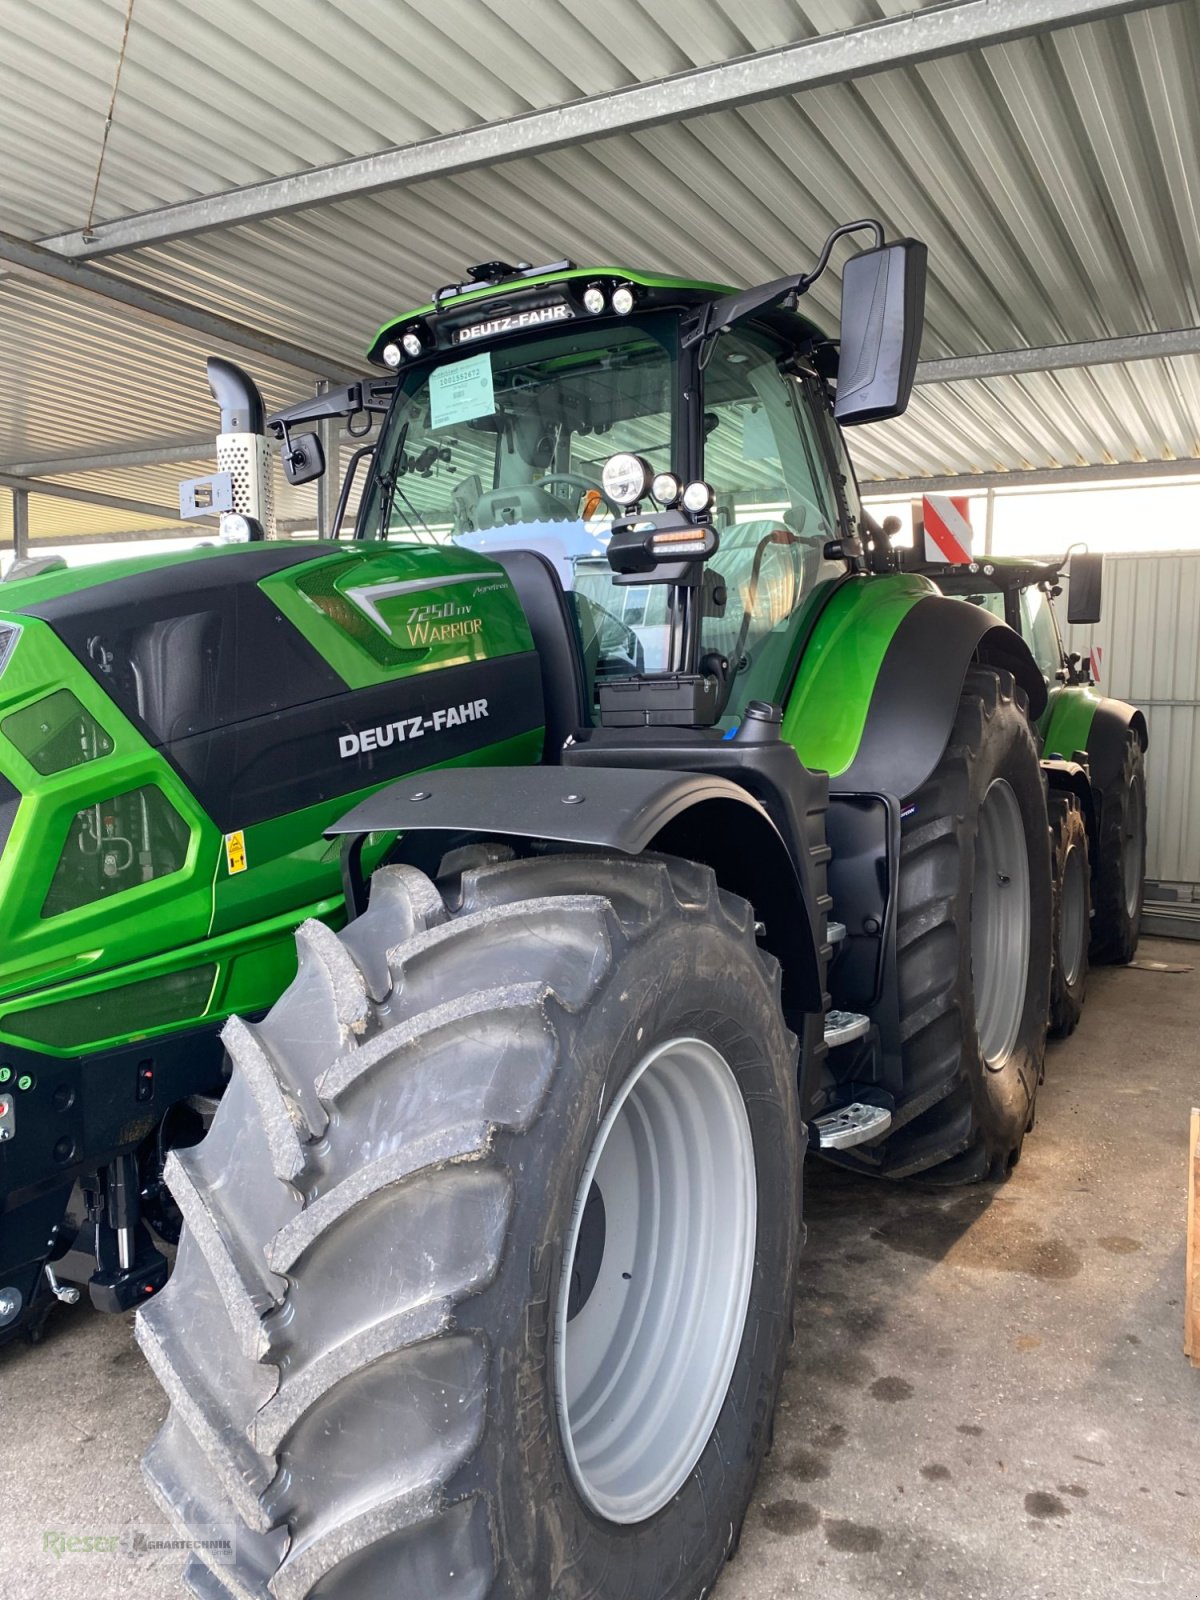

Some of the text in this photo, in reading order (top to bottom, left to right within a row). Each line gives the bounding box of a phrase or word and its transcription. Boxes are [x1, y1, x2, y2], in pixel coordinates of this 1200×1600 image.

[459, 305, 566, 341] DEUTZ-FAHR
[407, 602, 454, 624] 7250
[406, 618, 484, 647] WARRIOR
[338, 698, 489, 758] DEUTZ-FAHR
